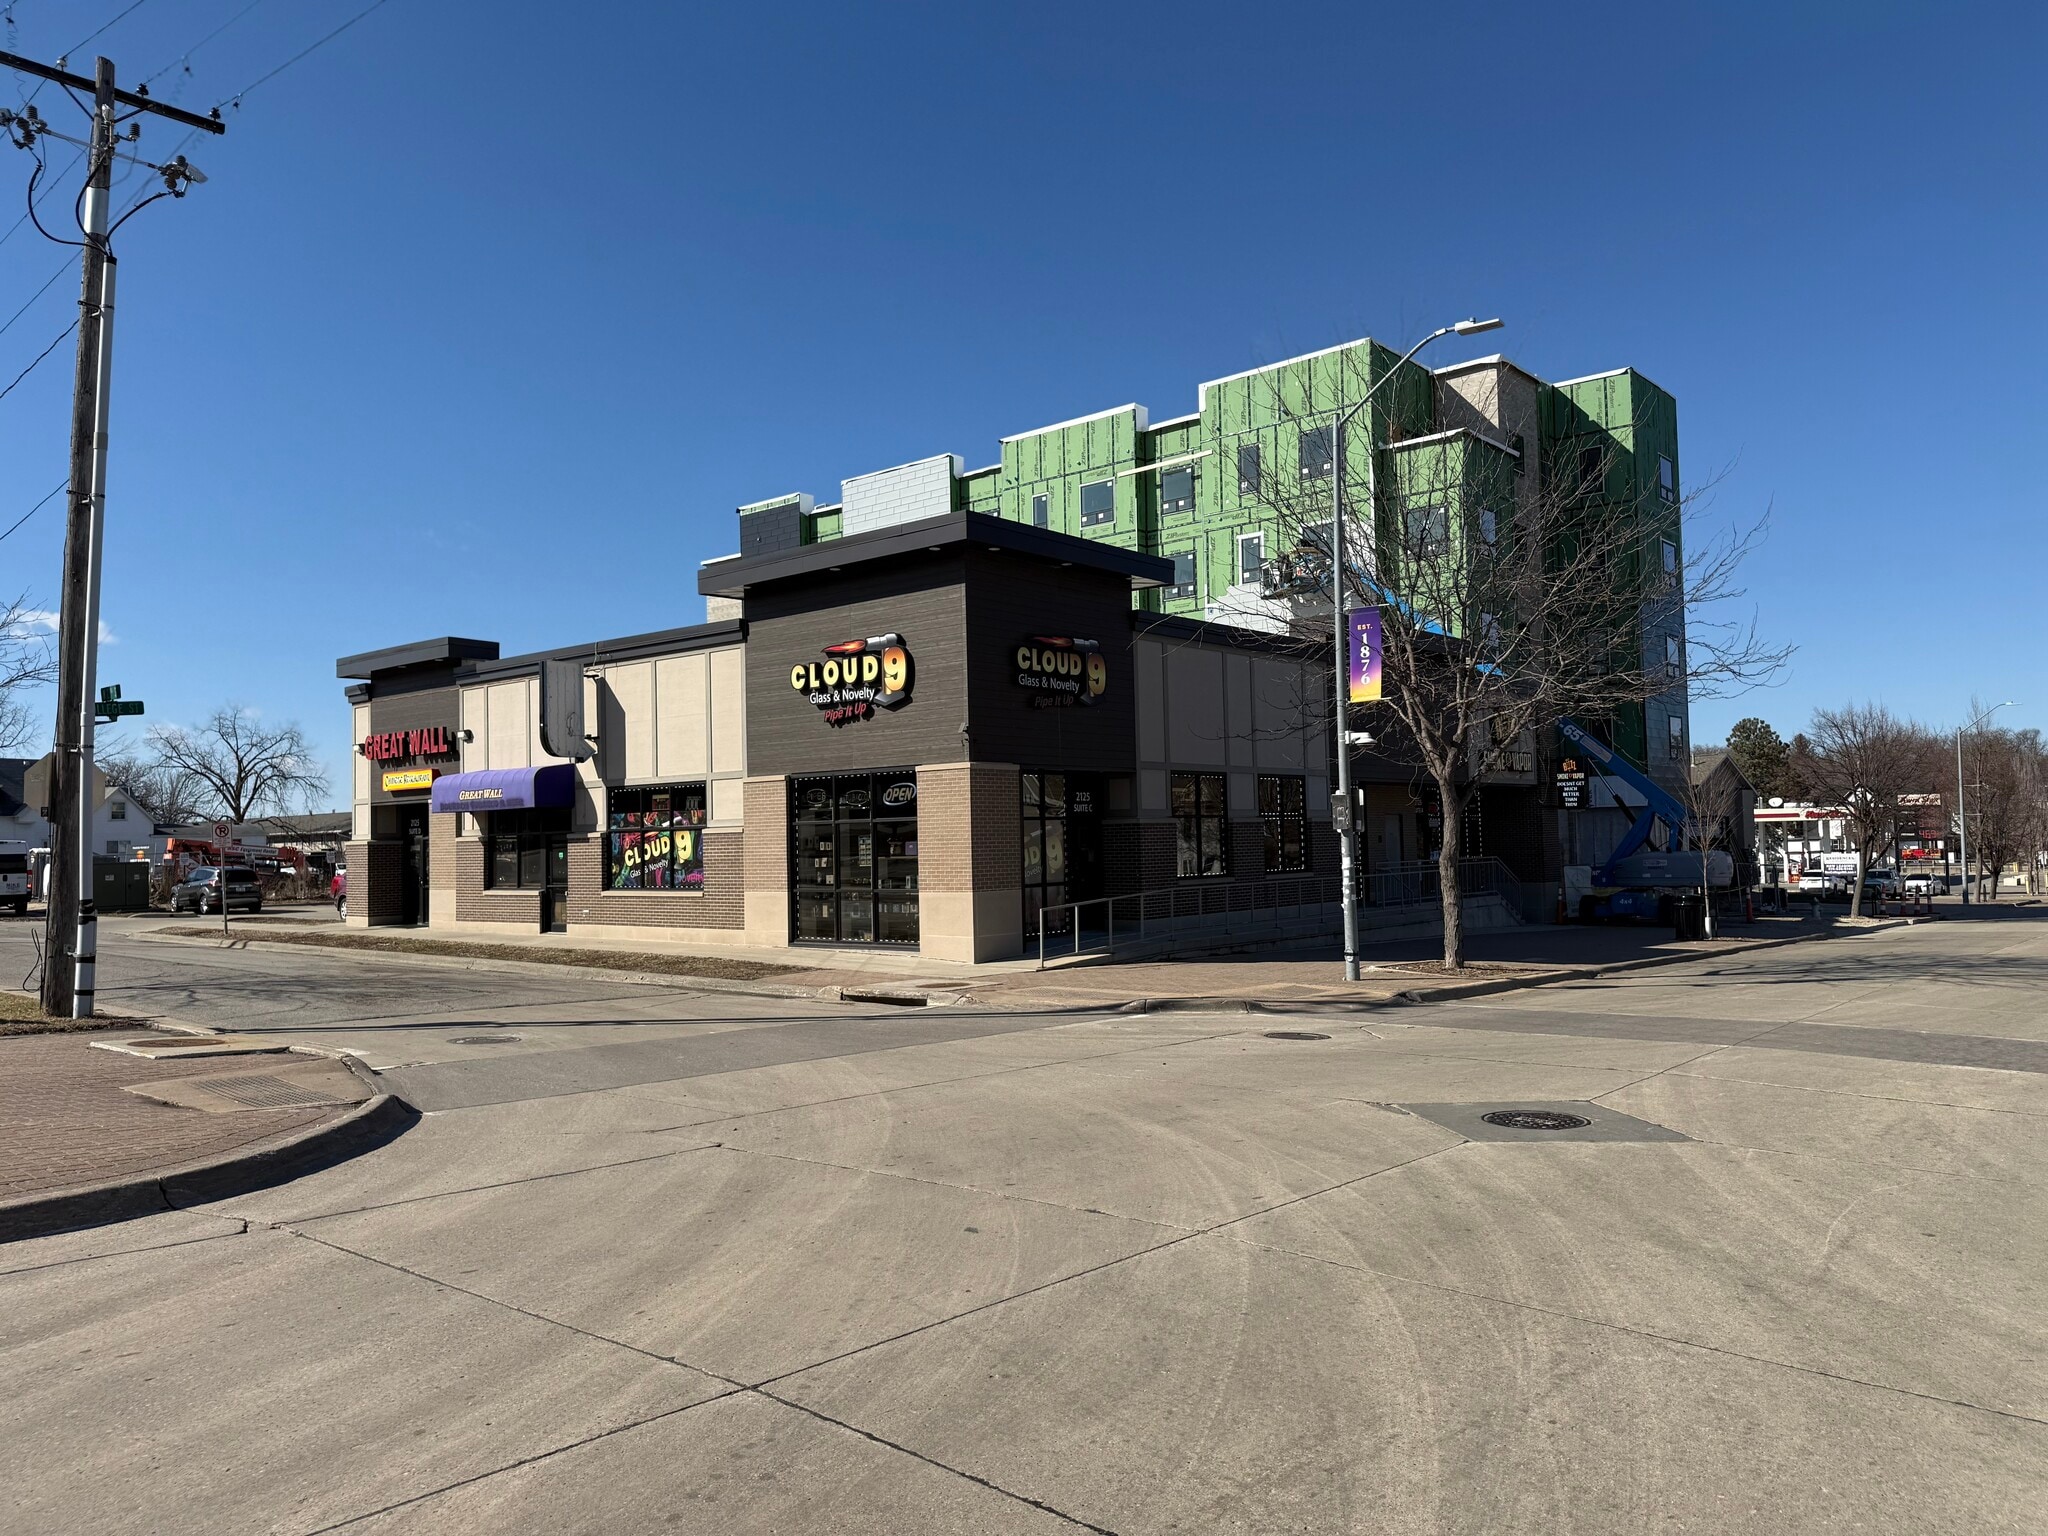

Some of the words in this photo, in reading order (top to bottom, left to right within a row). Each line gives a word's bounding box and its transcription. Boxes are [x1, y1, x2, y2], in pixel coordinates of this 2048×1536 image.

[1357, 623, 1373, 631] EST.
[1360, 632, 1371, 685] 1876
[791, 655, 879, 690] CLOUD
[883, 646, 907, 692] 9
[1017, 646, 1082, 676] CLOUD
[1087, 652, 1107, 695] 9
[1018, 673, 1040, 687] Glass
[1041, 676, 1048, 688] &
[1050, 677, 1080, 694] Novelty
[809, 691, 831, 704] Glass
[833, 690, 841, 701] &
[842, 687, 875, 702] Novelty
[1034, 695, 1053, 709] Pipe
[1055, 695, 1061, 706] It
[1063, 694, 1074, 707] Up
[824, 708, 844, 723] Pipe
[845, 705, 852, 718] It
[854, 703, 867, 716] Up
[365, 731, 405, 761] GREAT
[409, 726, 448, 756] WALL
[1512, 752, 1532, 771] VAPOR
[459, 790, 483, 801] GREAT
[483, 788, 503, 799] WALL
[885, 787, 913, 801] OPEN
[1075, 791, 1091, 802] 2125
[1074, 803, 1088, 812] SUITE
[1088, 803, 1093, 812] C
[629, 869, 641, 879] Glas
[649, 859, 669, 872] Novelty
